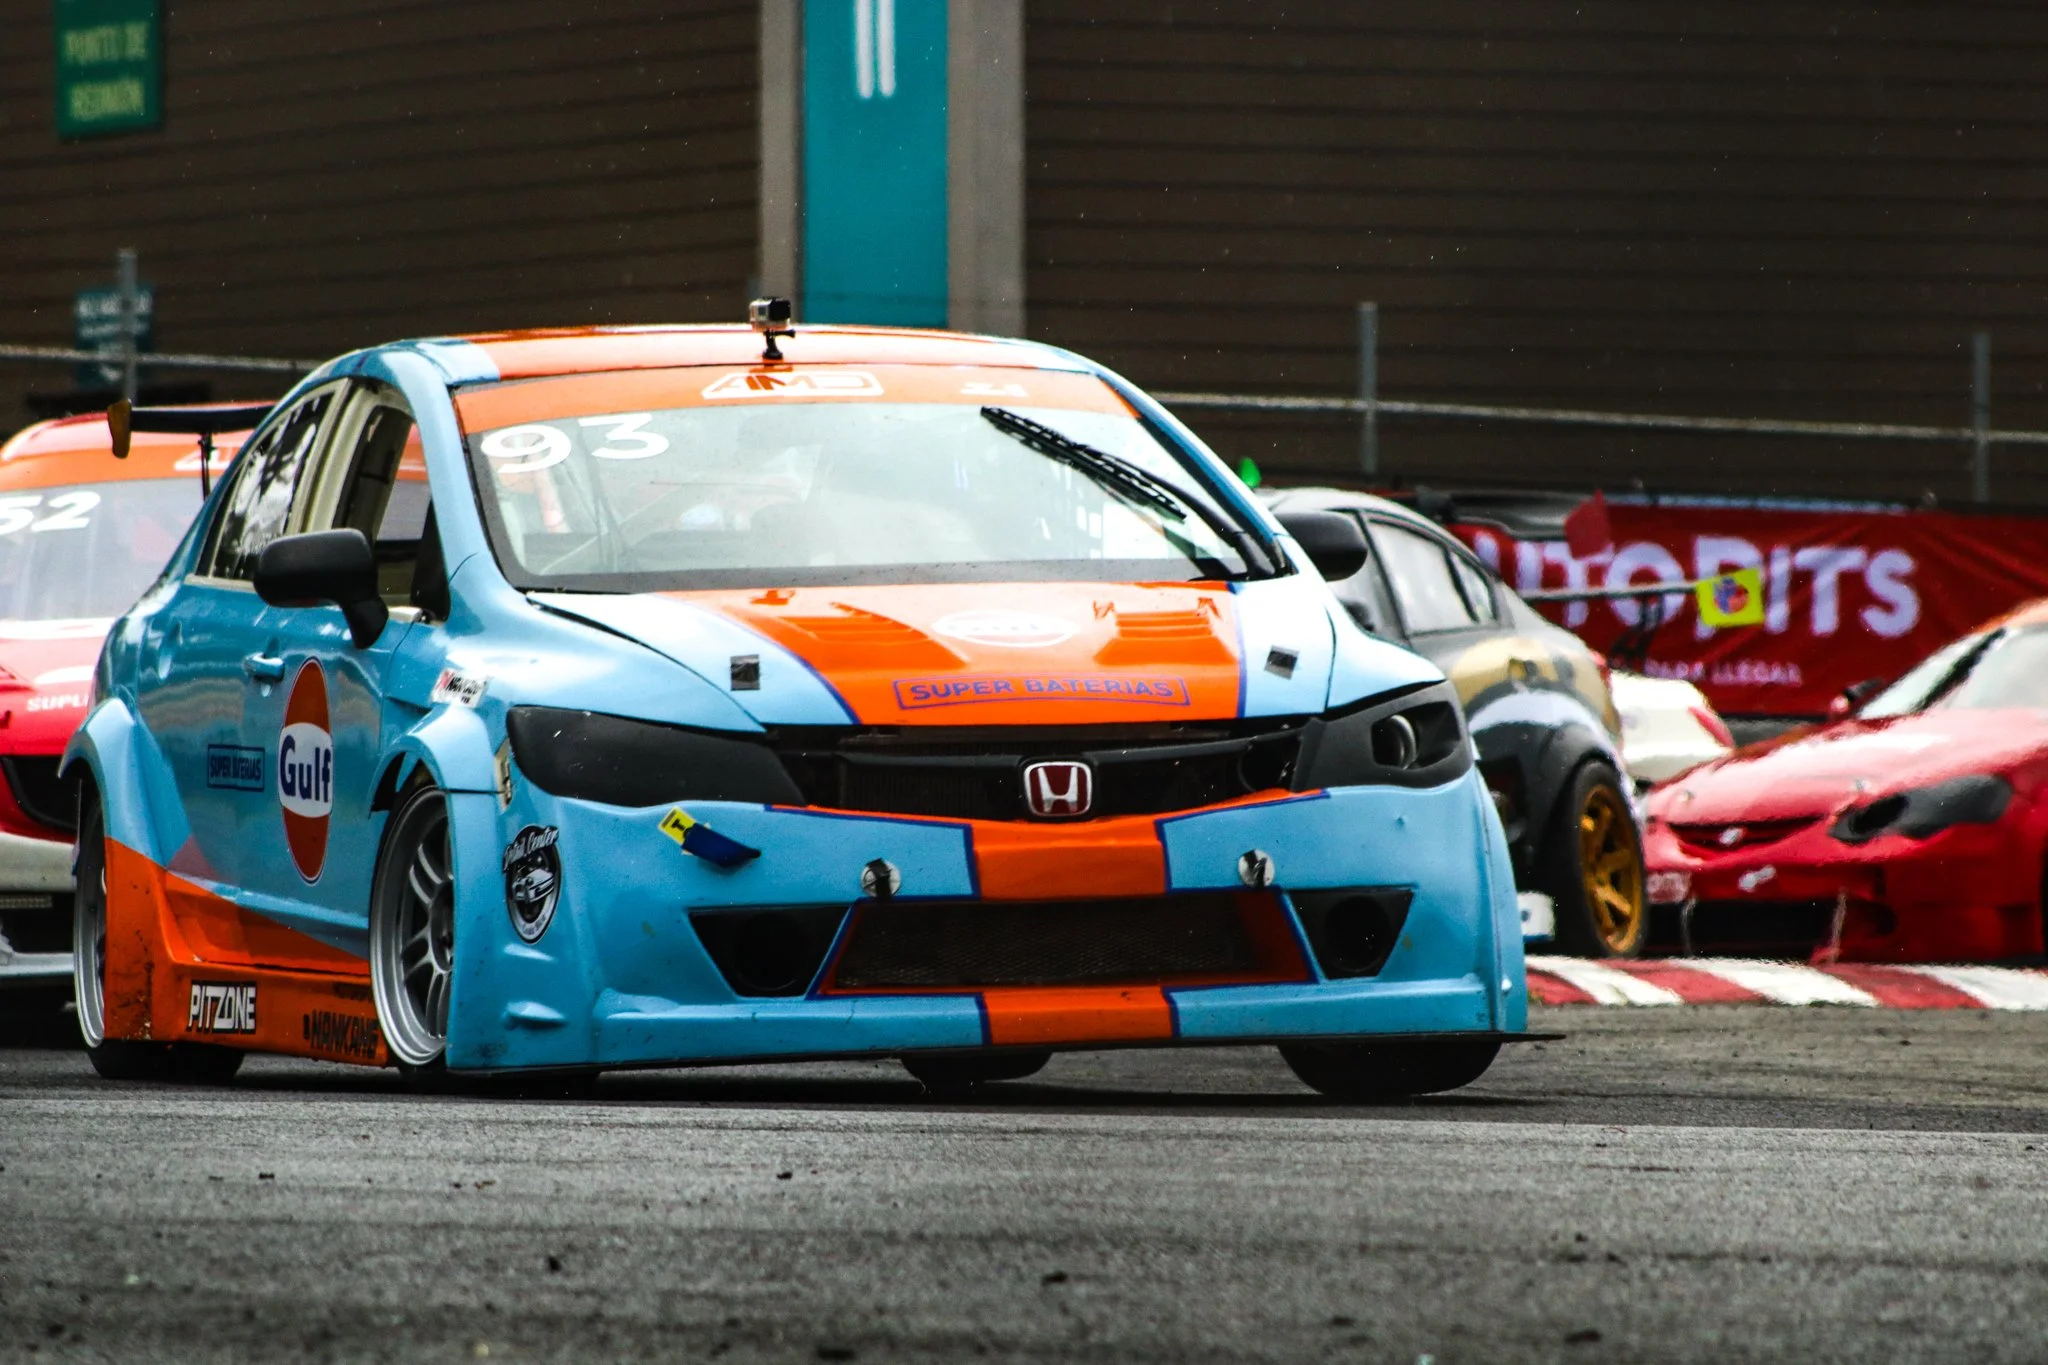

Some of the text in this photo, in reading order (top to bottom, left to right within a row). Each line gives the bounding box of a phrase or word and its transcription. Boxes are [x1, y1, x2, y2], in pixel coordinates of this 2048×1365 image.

[480, 413, 669, 473] 93
[909, 677, 1174, 701] SUPER BATERIAS
[280, 734, 332, 803] Gulf
[188, 984, 256, 1030] PITZONE
